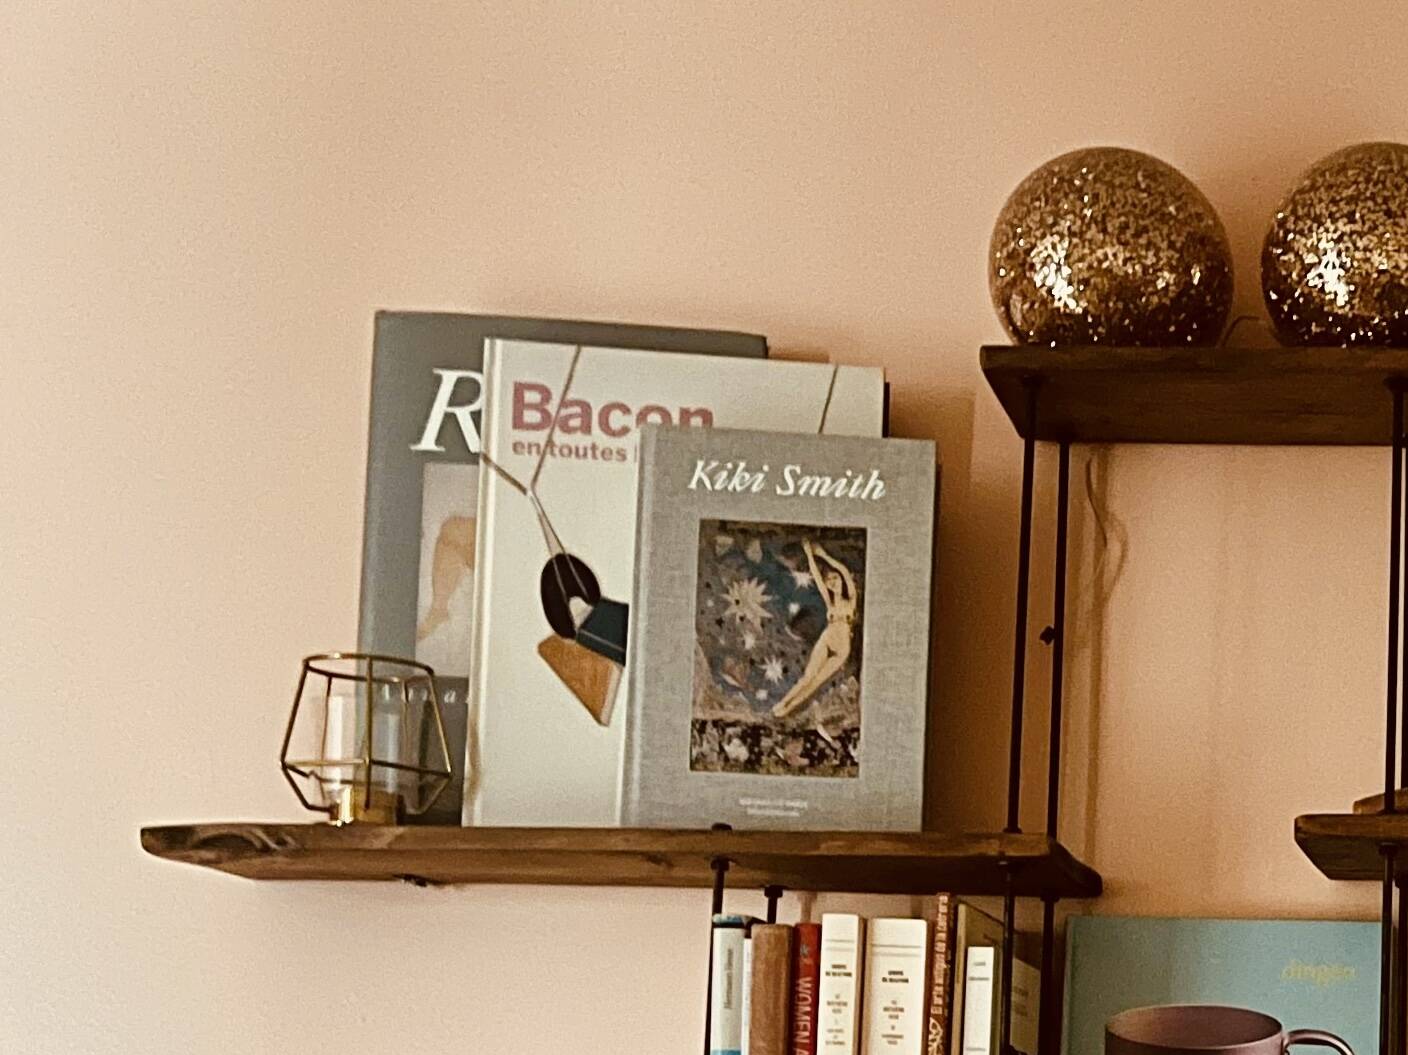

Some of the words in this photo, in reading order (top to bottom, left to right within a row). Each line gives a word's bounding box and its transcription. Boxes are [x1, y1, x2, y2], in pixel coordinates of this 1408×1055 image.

[512, 440, 543, 455] en
[550, 440, 628, 462] toutes
[688, 460, 770, 493] Kiki
[775, 464, 886, 500] Smith
[794, 976, 813, 1043] WOMEN
